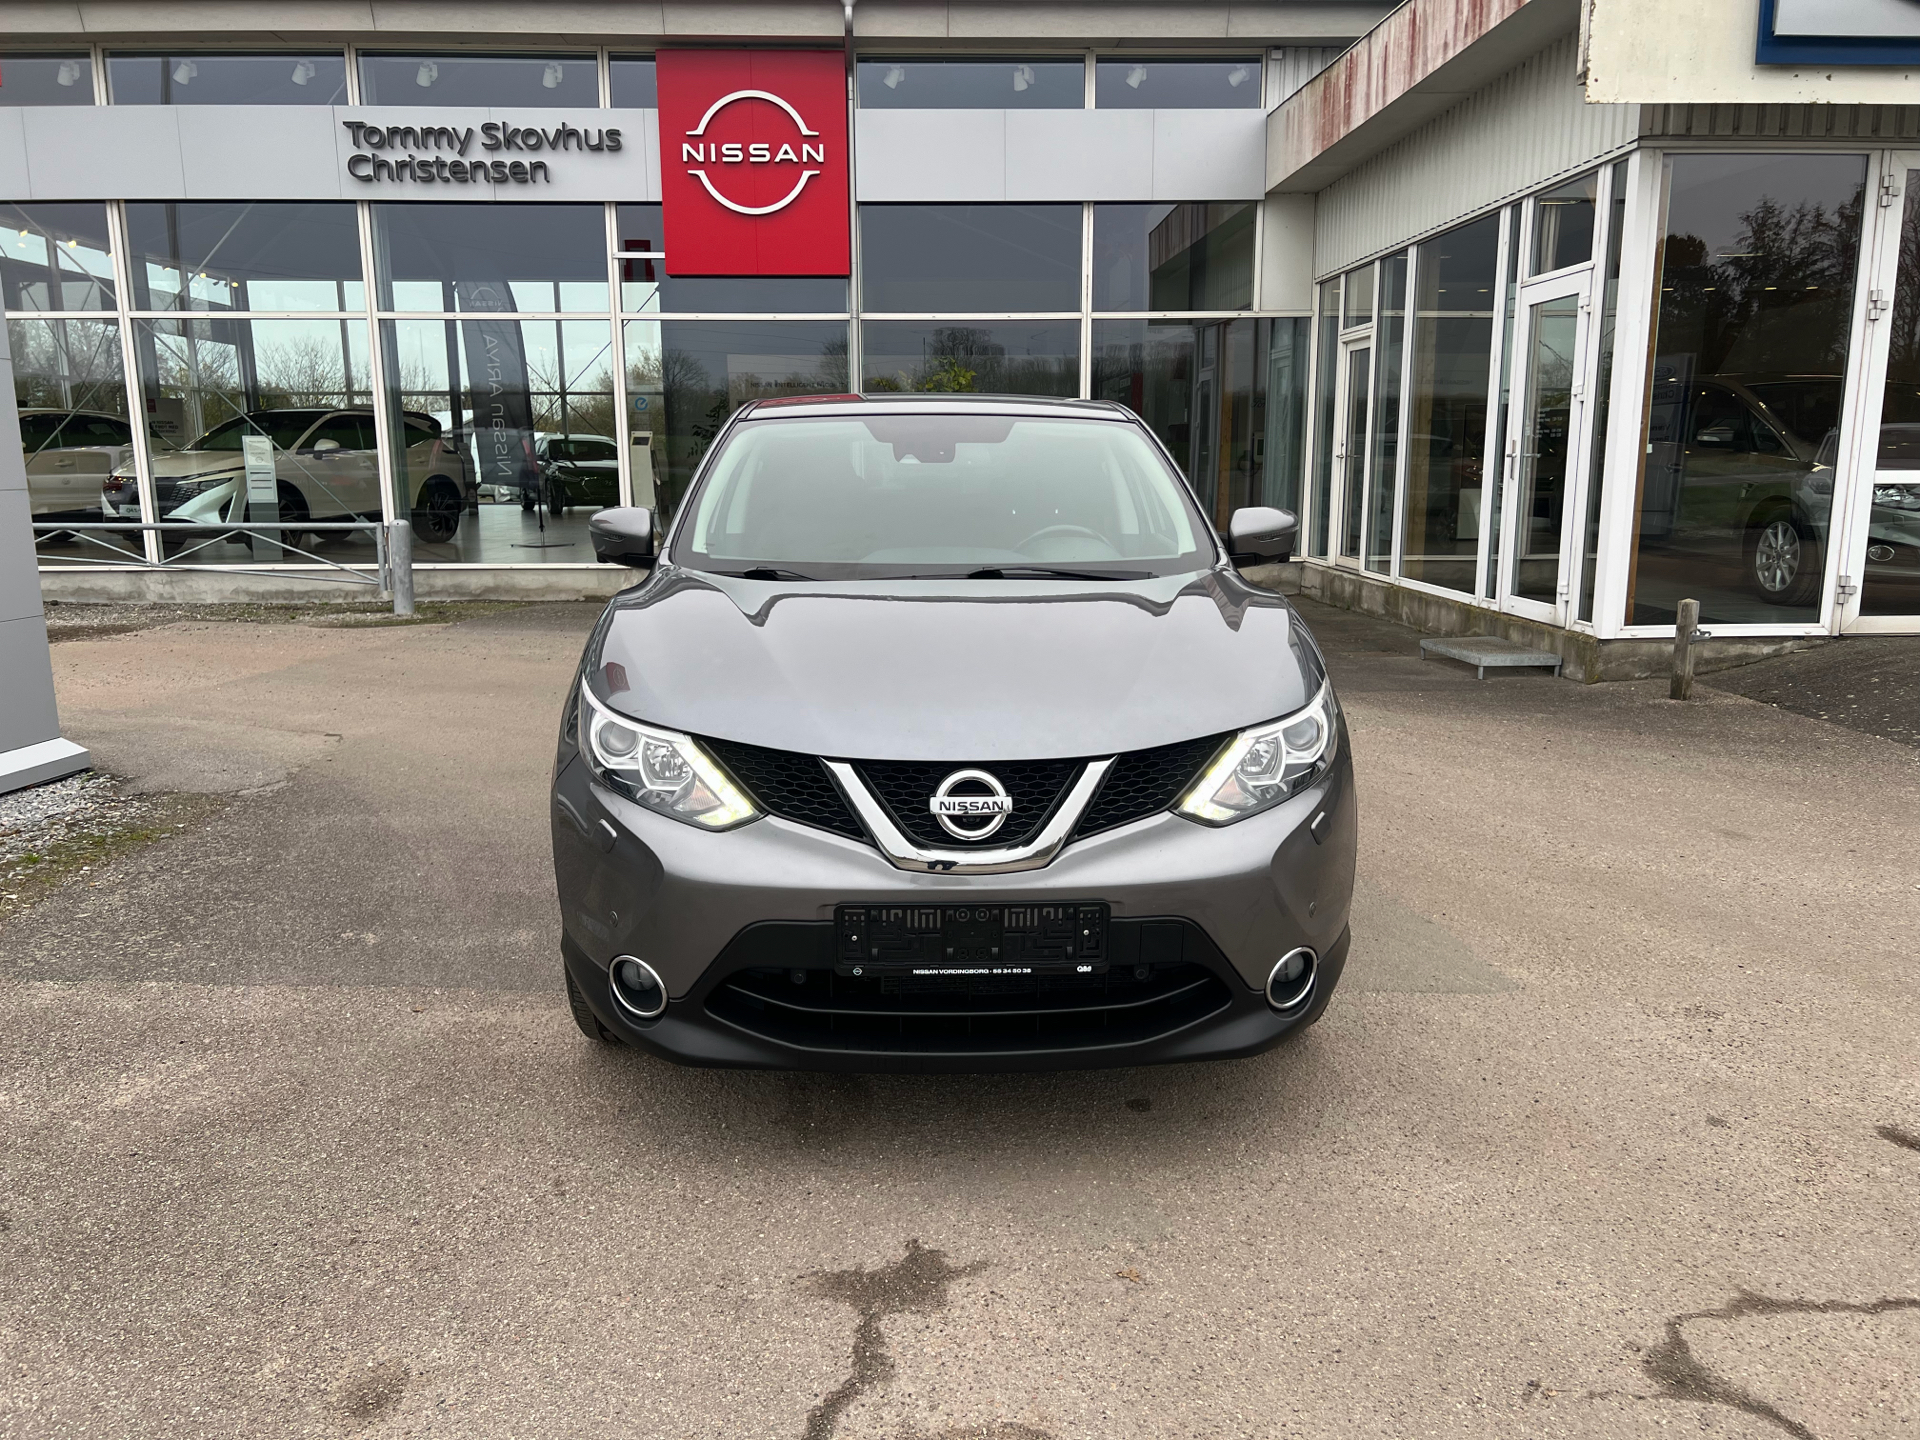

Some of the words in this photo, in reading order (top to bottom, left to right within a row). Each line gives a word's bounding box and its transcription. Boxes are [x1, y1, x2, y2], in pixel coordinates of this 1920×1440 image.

[343, 121, 474, 156] Tommy
[480, 122, 622, 151] Skovhus
[682, 143, 825, 163] NISSAN
[347, 154, 550, 182] Christensen
[939, 801, 1004, 811] NISSAN
